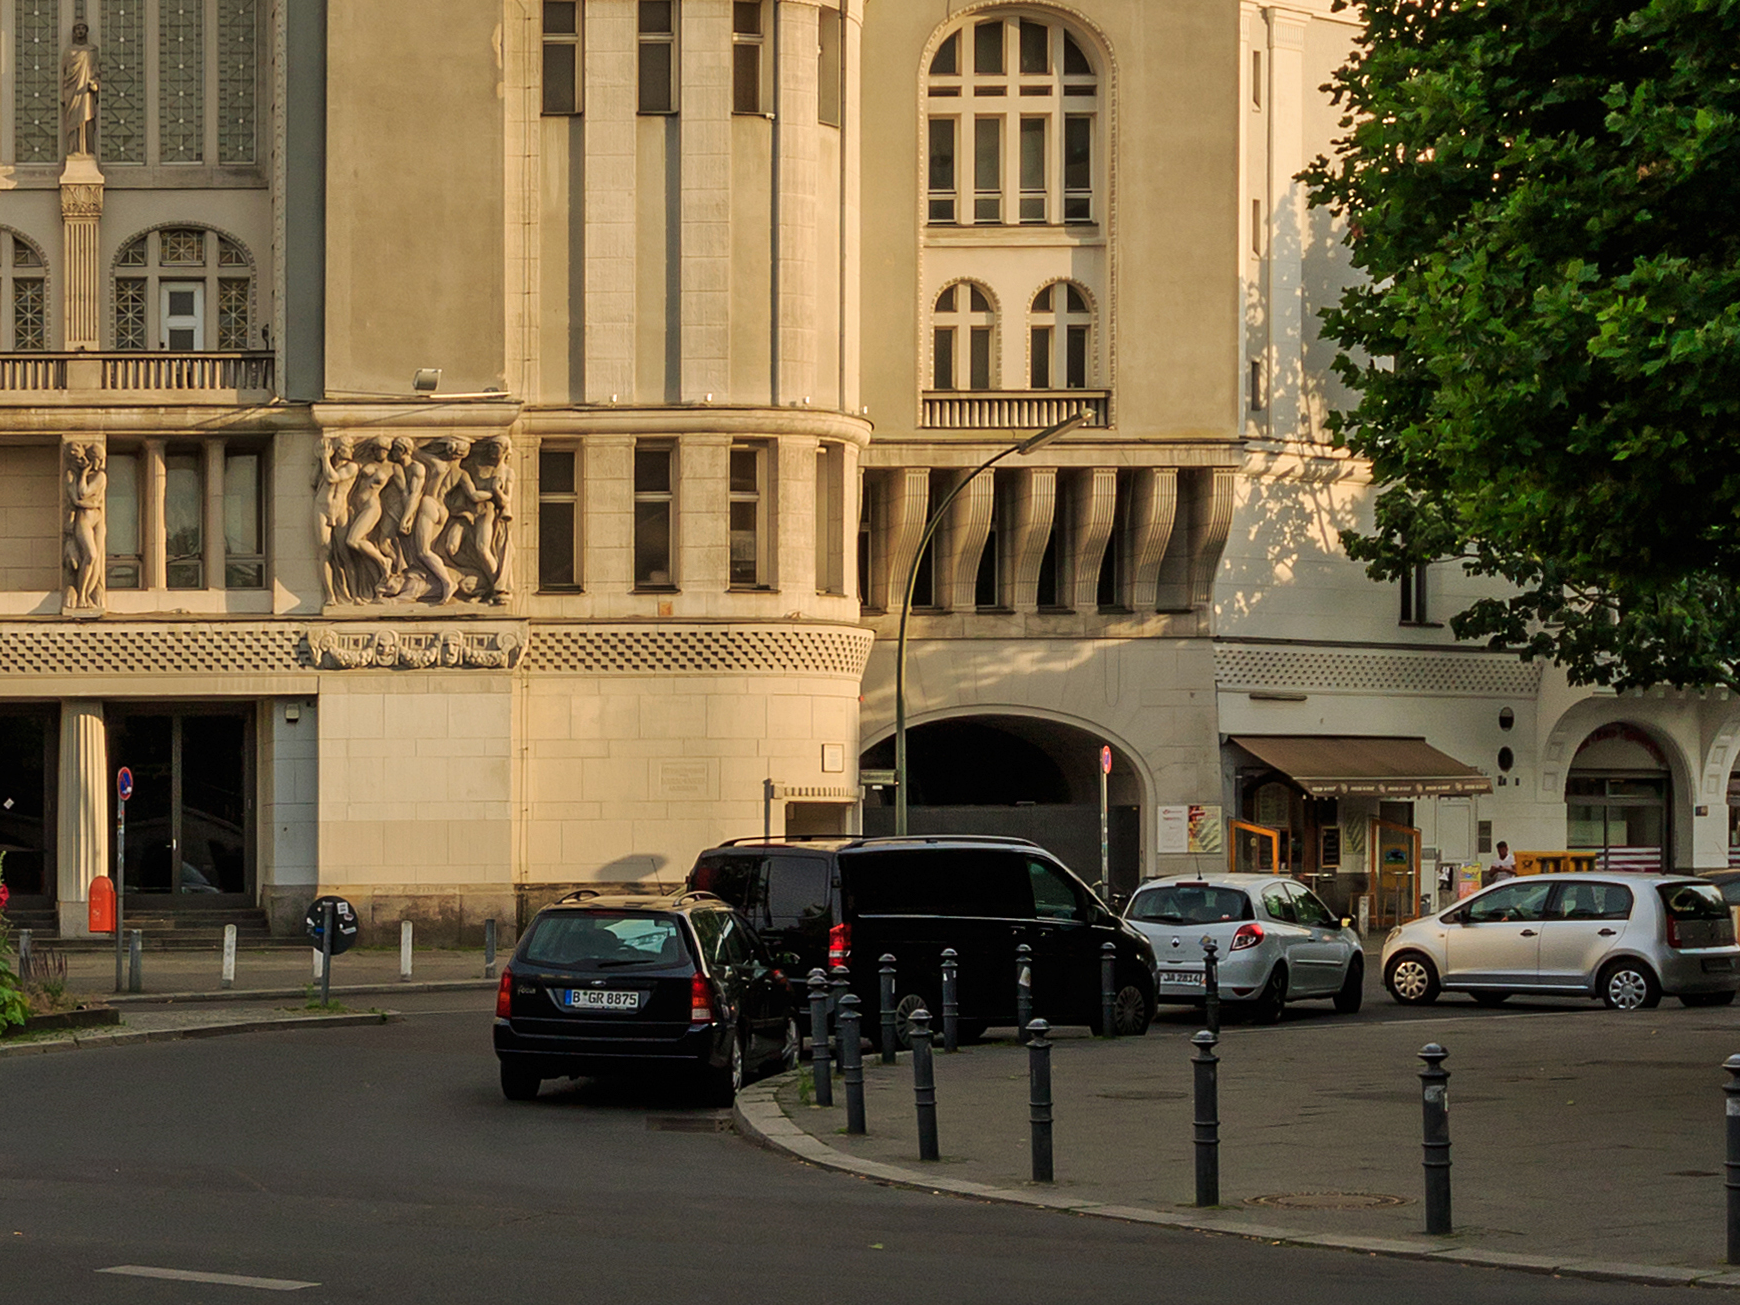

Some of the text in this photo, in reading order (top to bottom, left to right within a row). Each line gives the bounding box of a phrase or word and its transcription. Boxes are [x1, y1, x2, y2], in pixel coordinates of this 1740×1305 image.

[572, 991, 637, 1006] B GR 8875
